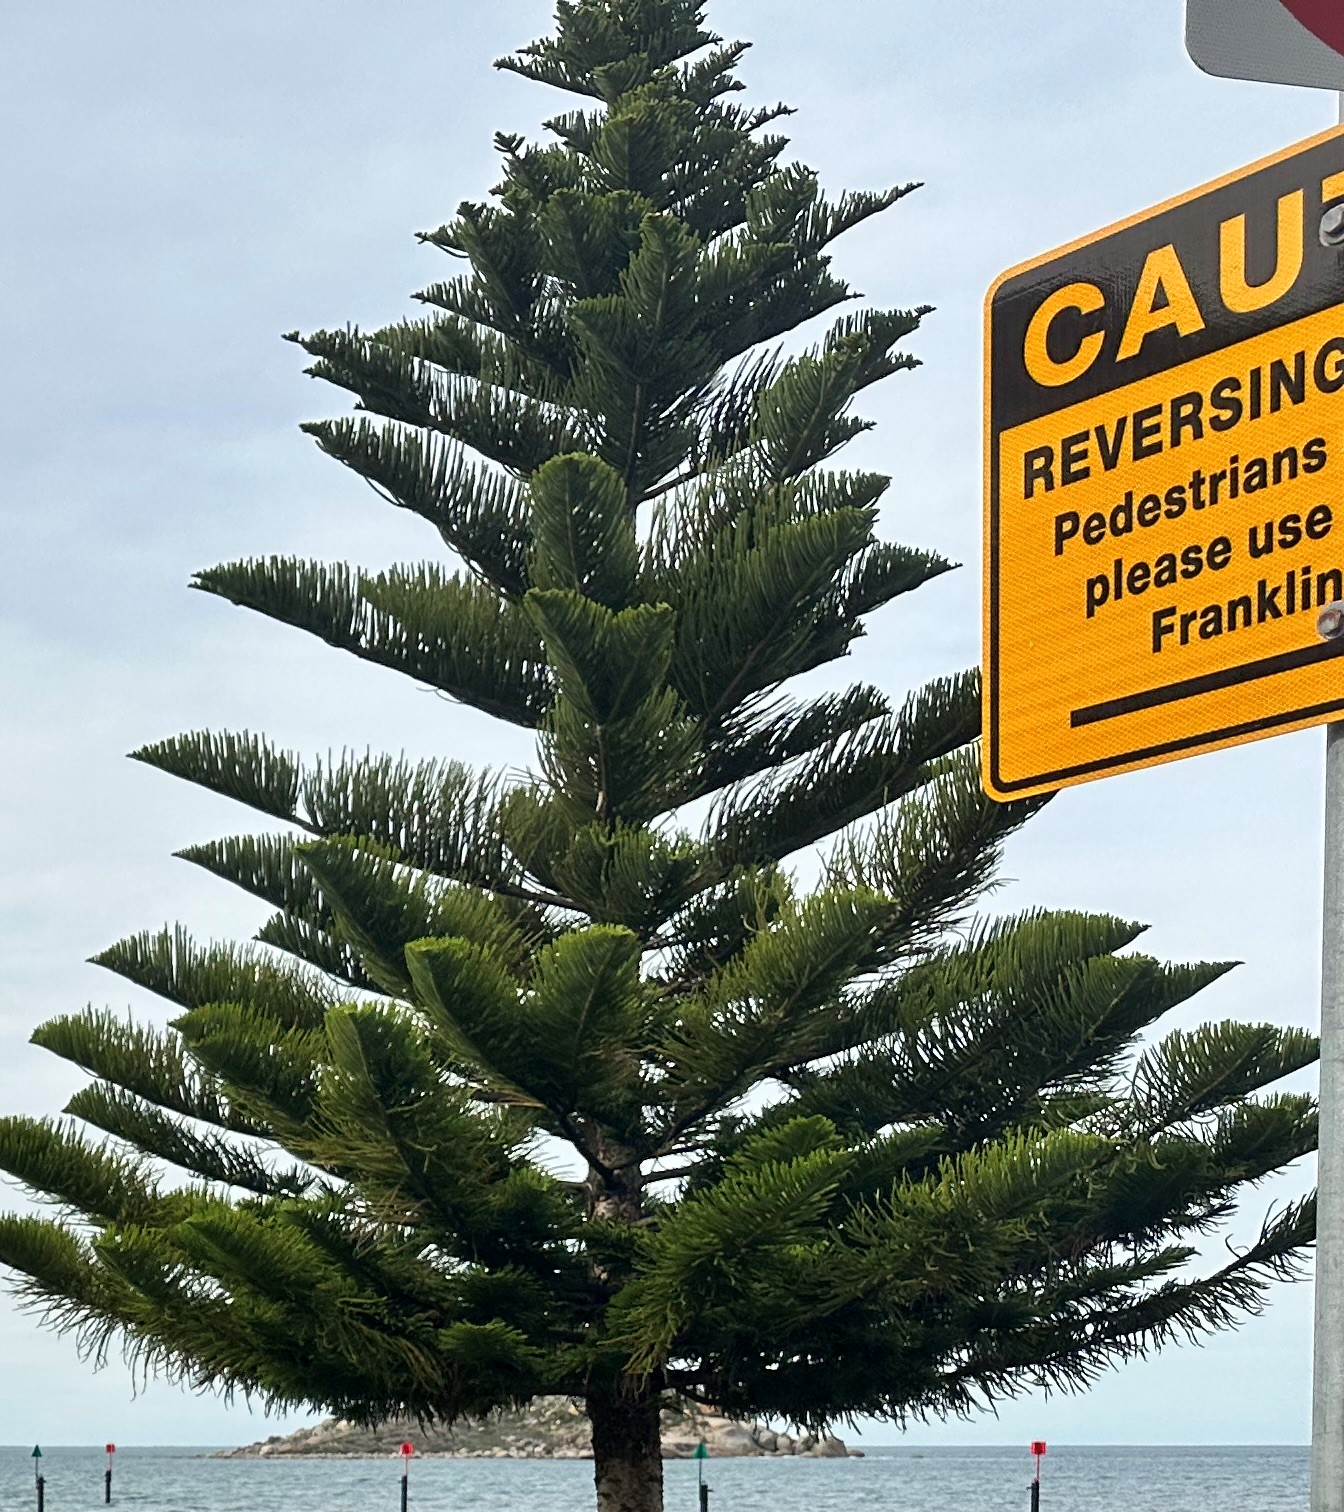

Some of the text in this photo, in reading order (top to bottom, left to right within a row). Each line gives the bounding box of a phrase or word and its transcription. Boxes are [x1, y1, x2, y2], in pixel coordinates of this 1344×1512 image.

[1023, 170, 1344, 387] CAU
[1023, 336, 1344, 500] REVERSING
[1054, 437, 1328, 557] Pedestrians
[1085, 504, 1333, 619] please use
[1152, 565, 1344, 654] Franklin
